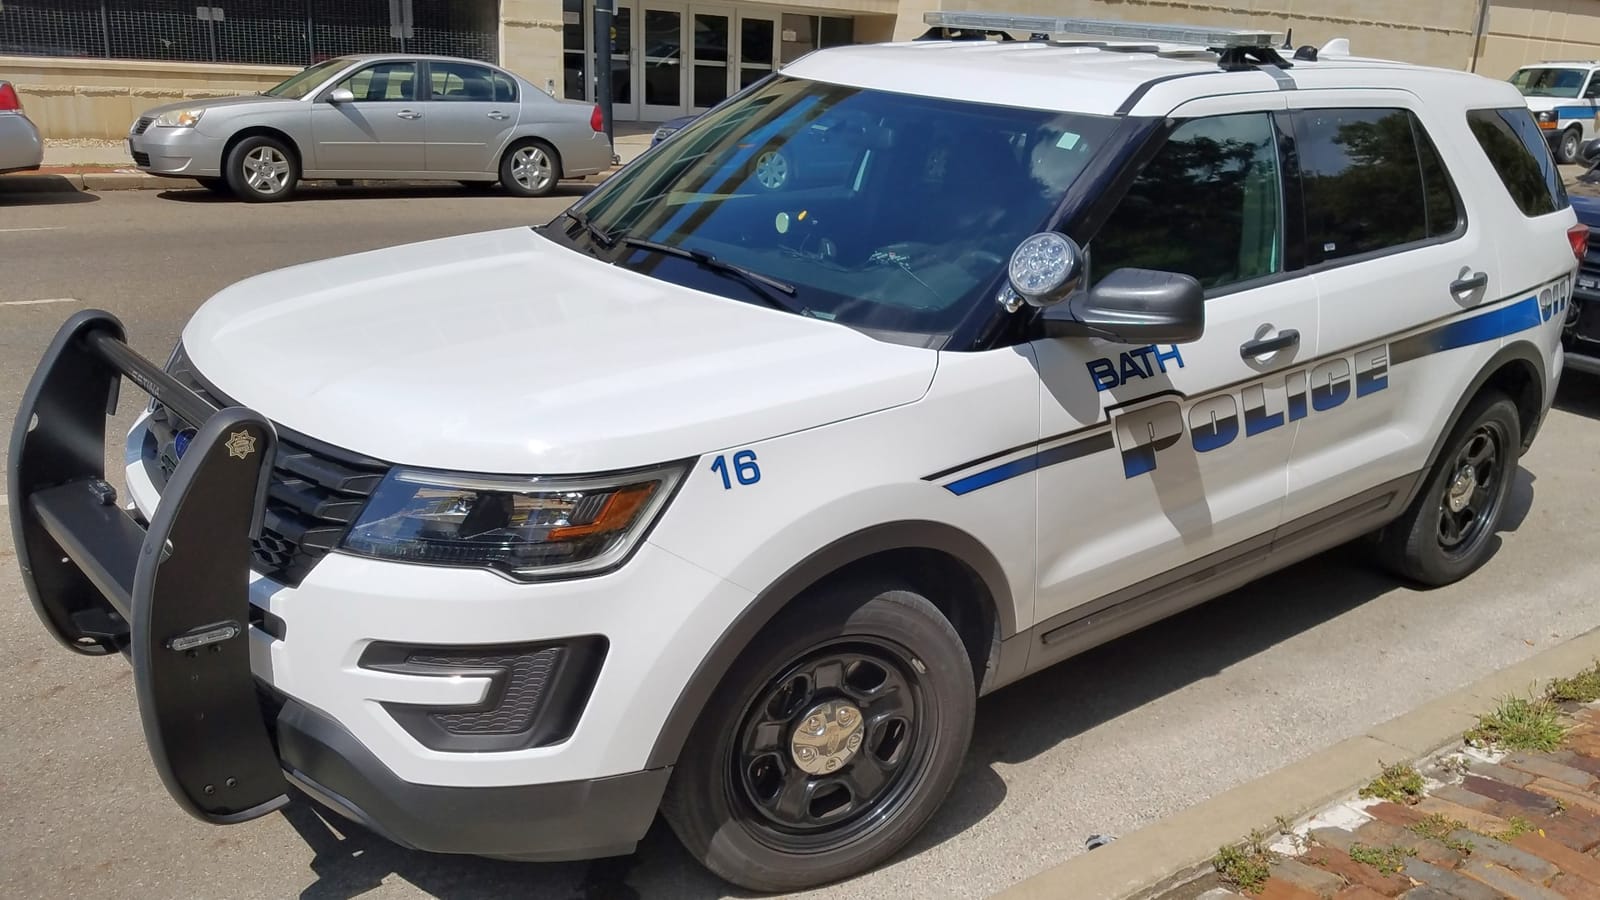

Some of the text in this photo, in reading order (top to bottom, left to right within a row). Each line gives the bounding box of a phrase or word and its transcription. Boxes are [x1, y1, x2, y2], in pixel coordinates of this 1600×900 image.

[1085, 344, 1185, 392] BATH
[1115, 343, 1389, 479] POLICE
[711, 449, 761, 489] 16
